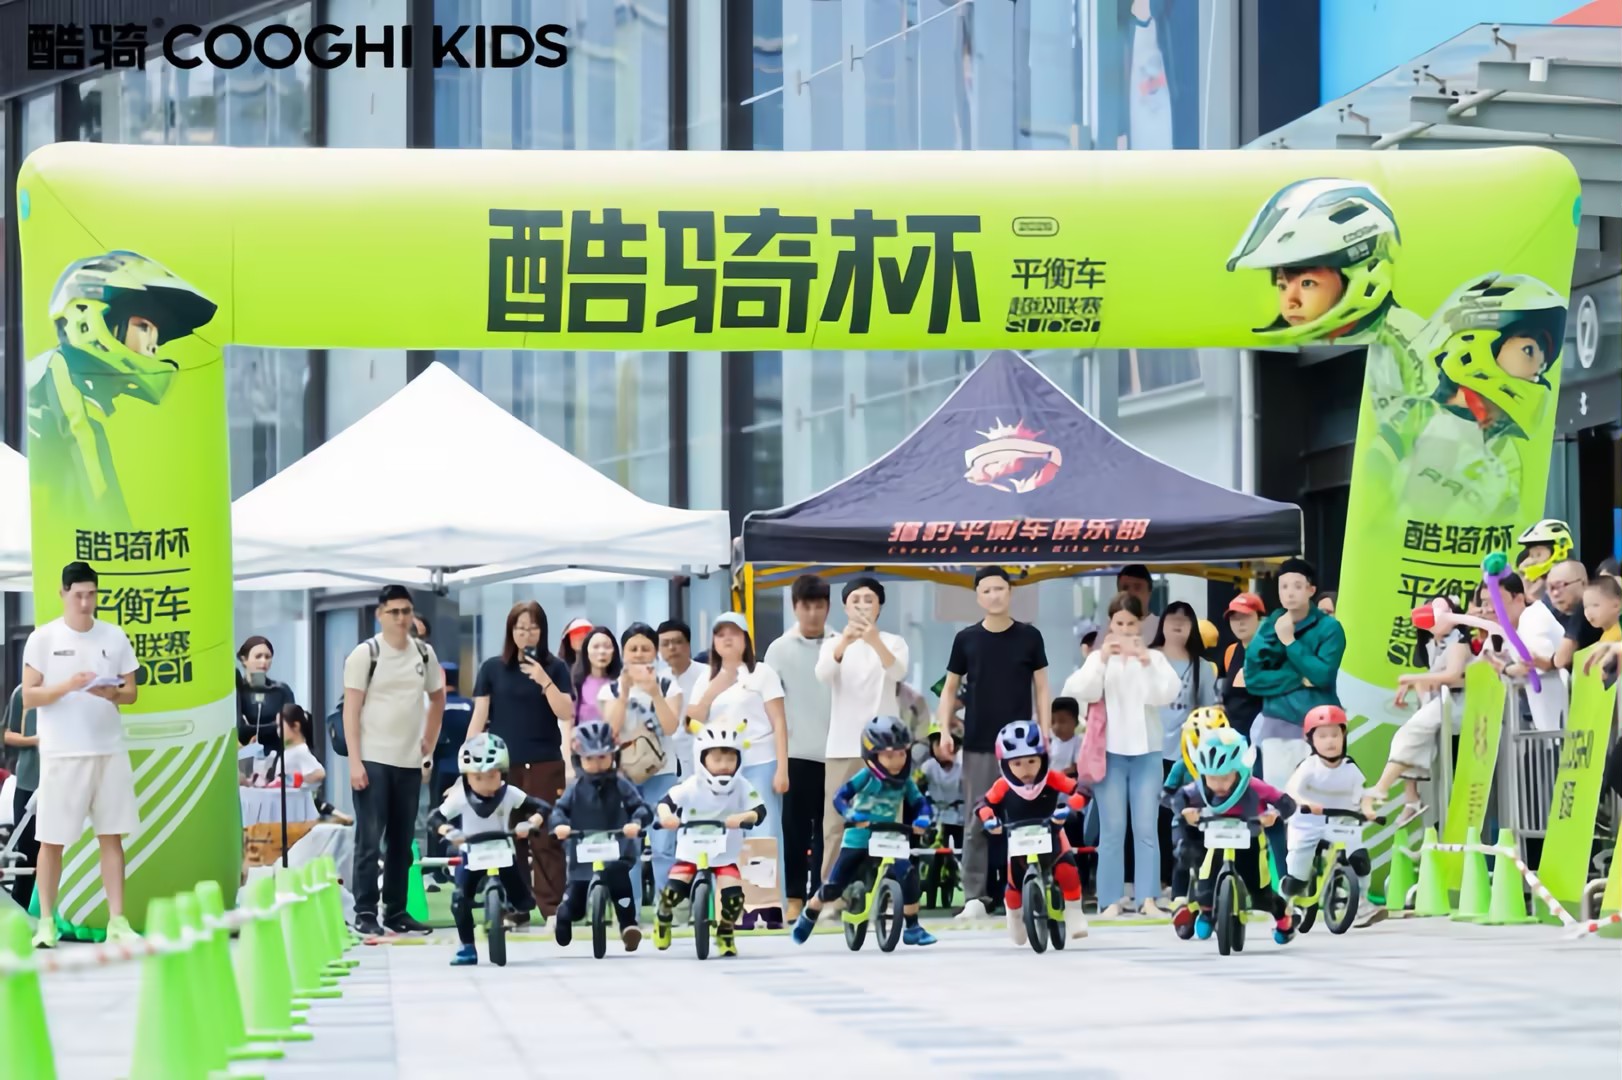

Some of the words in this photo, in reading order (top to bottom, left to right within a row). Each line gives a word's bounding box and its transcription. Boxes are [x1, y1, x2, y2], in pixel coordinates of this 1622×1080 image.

[487, 207, 982, 334] 酷骑杯
[1011, 257, 1106, 289] 平衡车
[76, 527, 190, 562] 酷骑杯
[1404, 520, 1515, 555] 酷骑杯
